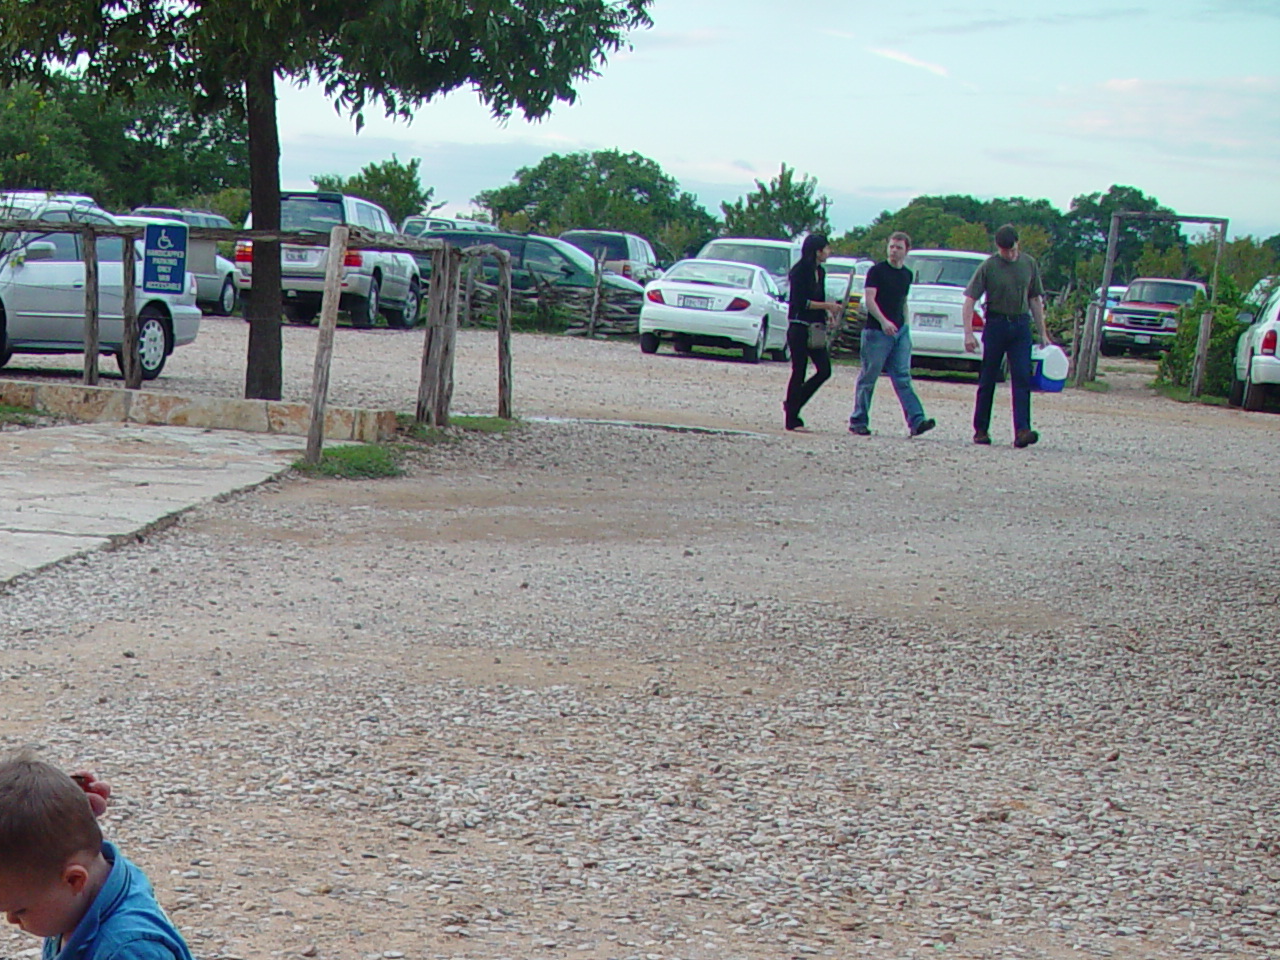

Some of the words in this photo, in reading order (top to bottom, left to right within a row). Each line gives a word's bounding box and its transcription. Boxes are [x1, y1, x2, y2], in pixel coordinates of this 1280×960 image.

[146, 249, 185, 258] HANDICAPPED
[152, 257, 178, 266] PARKING
[156, 265, 172, 273] ONLY
[145, 281, 182, 290] ACCESSIBLE
